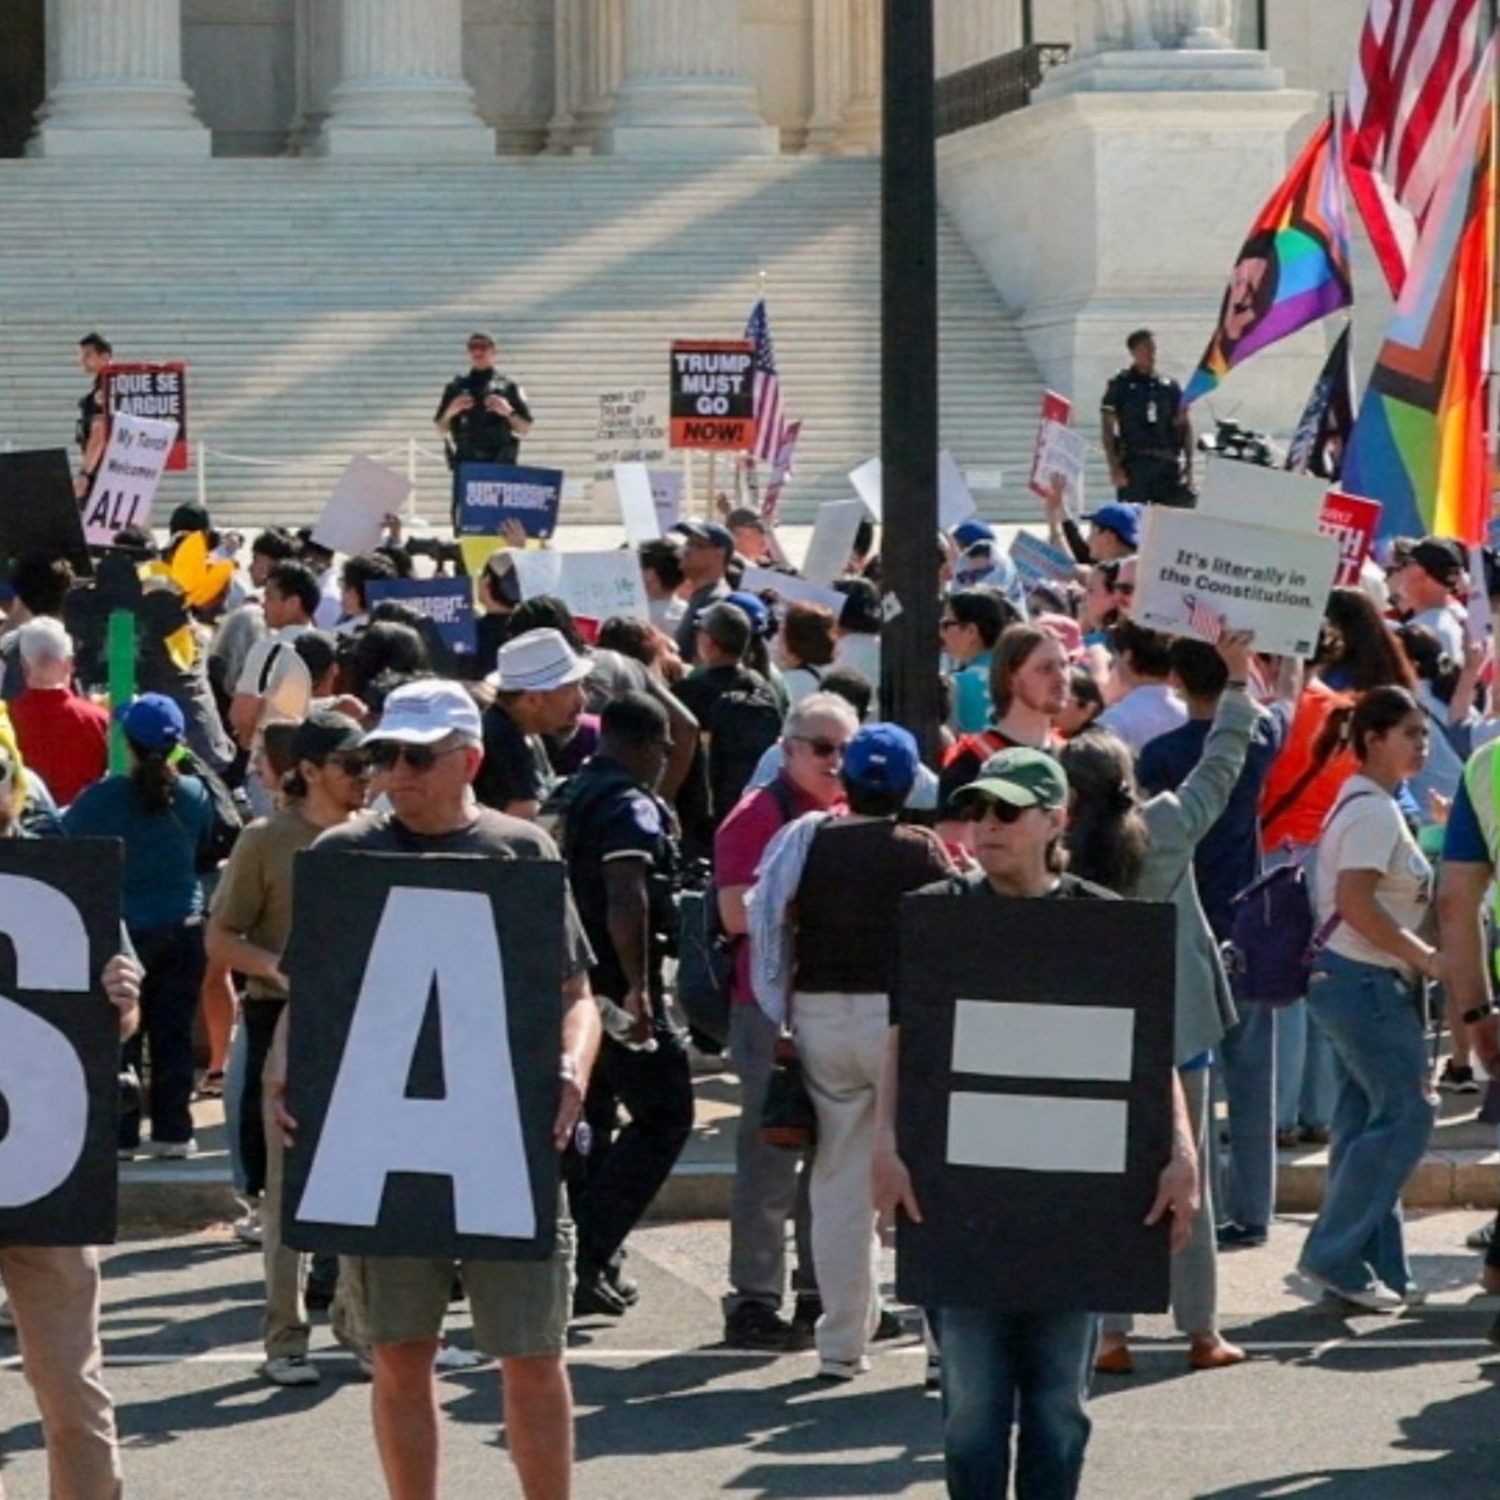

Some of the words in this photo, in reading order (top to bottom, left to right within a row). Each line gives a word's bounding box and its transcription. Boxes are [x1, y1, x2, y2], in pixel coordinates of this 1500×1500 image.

[674, 353, 751, 373] TRUMP
[156, 375, 180, 393] SE
[682, 374, 744, 394] MUST
[109, 394, 180, 416] LARGUE
[696, 396, 729, 415] GO
[117, 427, 134, 448] My
[136, 431, 169, 451] Torch
[683, 421, 744, 443] NOW!
[86, 490, 141, 531] ALL
[1175, 549, 1208, 569] It's
[1211, 557, 1287, 587] literally
[1288, 569, 1307, 587] in
[1159, 567, 1192, 587] the
[1194, 574, 1315, 609] Constitution.
[295, 885, 536, 1239] A
